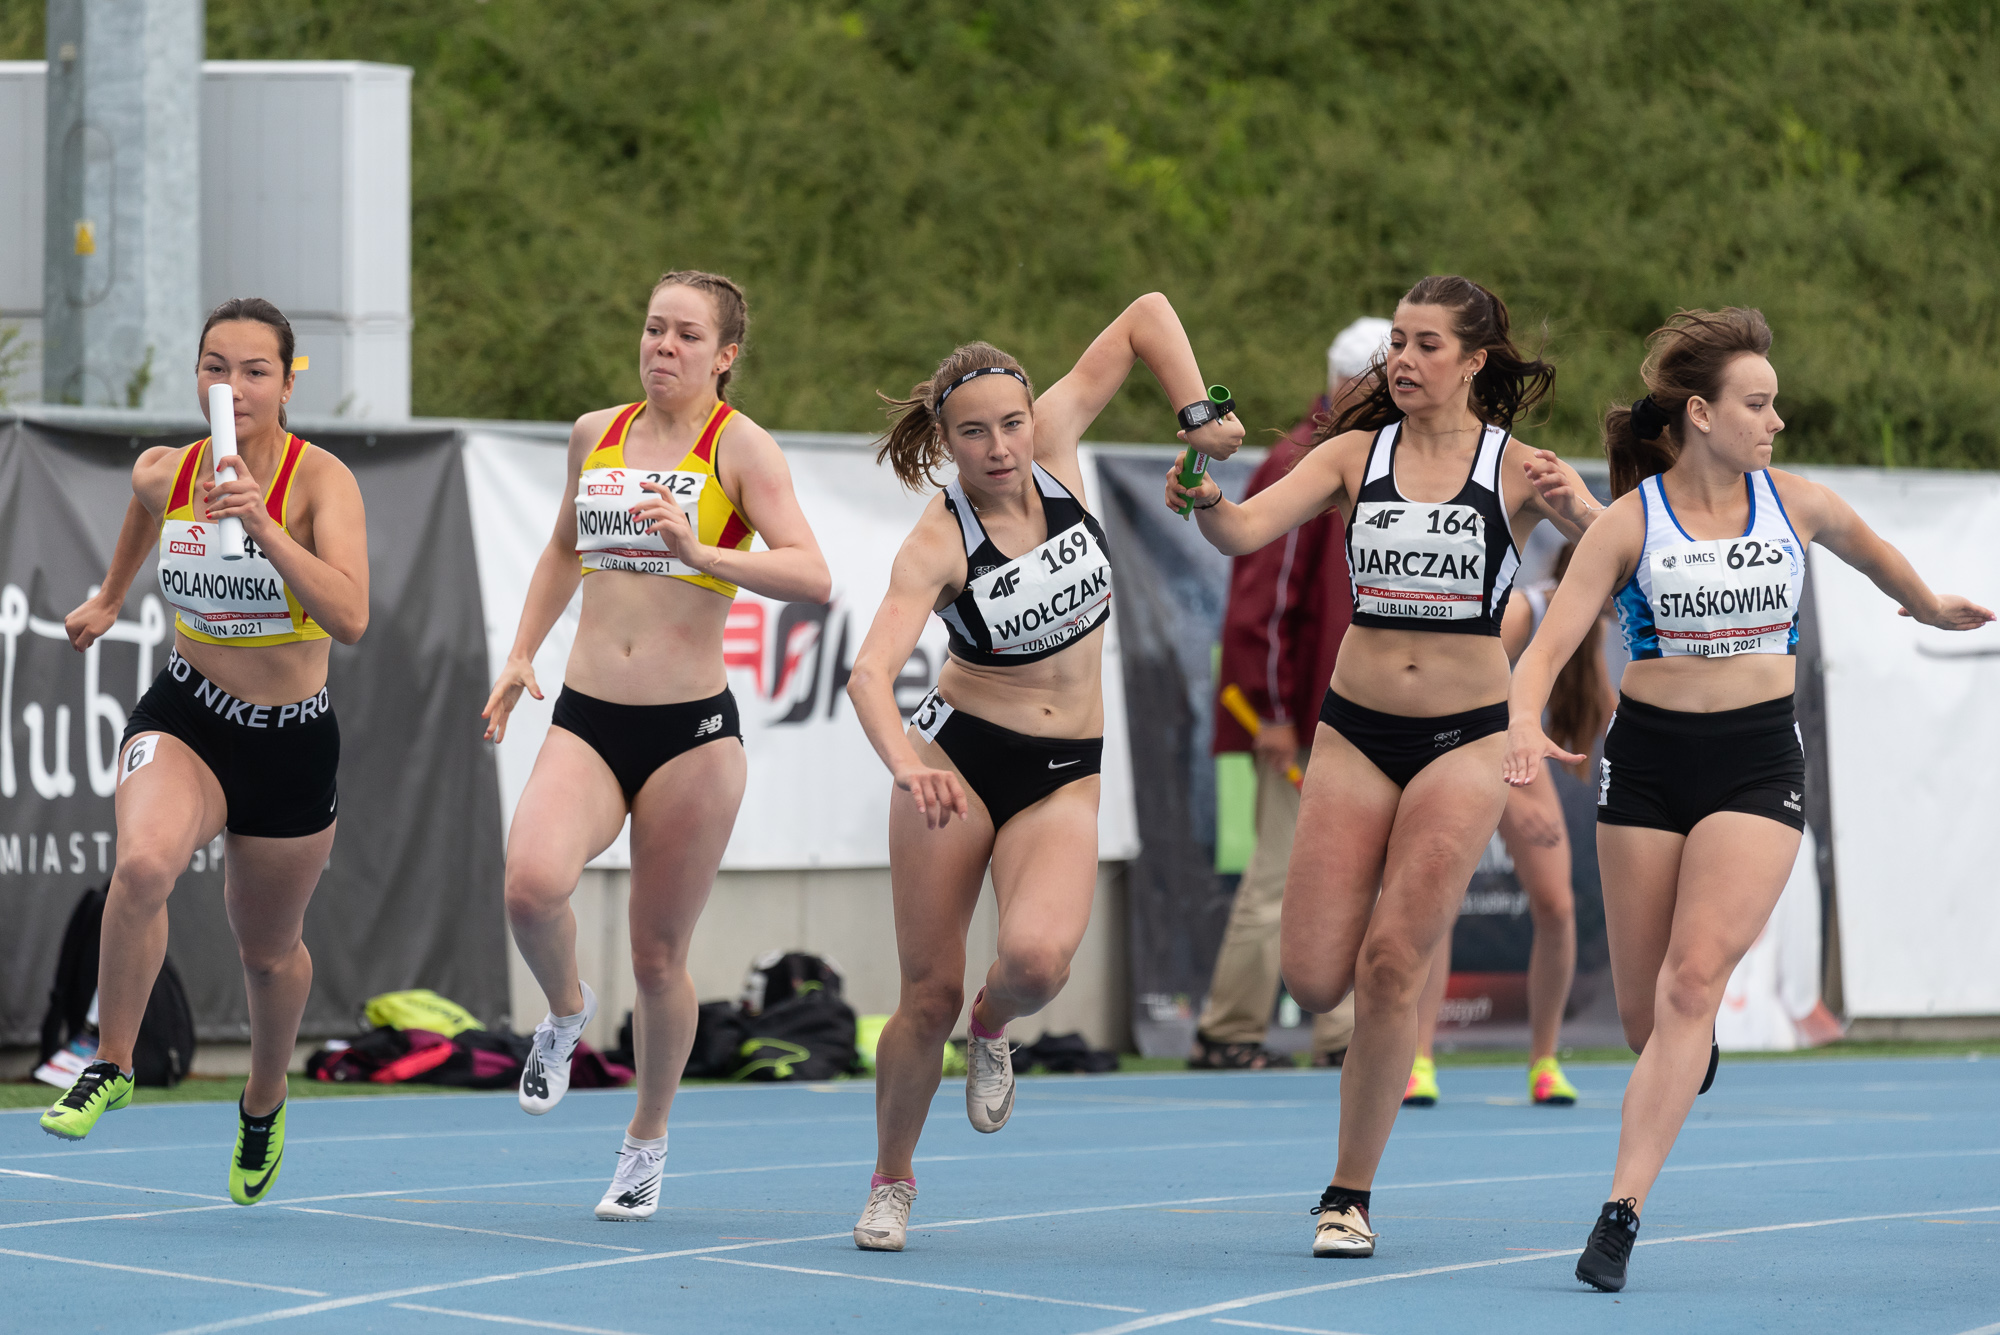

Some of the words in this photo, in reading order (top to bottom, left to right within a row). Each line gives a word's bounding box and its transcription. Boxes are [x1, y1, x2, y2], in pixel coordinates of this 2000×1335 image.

[962, 370, 978, 382] NIKE
[588, 485, 623, 496] ORLEN
[641, 473, 696, 496] 242
[579, 510, 692, 537] NOWAKOW
[1365, 509, 1405, 529] 4F
[1427, 510, 1478, 536] 164
[171, 542, 204, 555] ORLEN
[1041, 531, 1088, 574] 169
[1684, 552, 1715, 564] UMCS
[1726, 540, 1783, 570] 623
[600, 556, 637, 572] LUBLIN
[640, 561, 671, 573] 2021
[1358, 548, 1479, 580] JARCZAK
[162, 568, 281, 601] POLANOWSKA
[988, 566, 1021, 600] 4F
[1384, 590, 1435, 600] MISTRZOSTWA
[994, 566, 1108, 641] WOŁCZAK
[1377, 601, 1418, 616] LUBLIN
[1422, 605, 1453, 617] 2021
[1660, 582, 1788, 618] STAŚKOWIAK
[194, 617, 228, 636] LUBLIN
[231, 621, 263, 636] 2021
[1694, 628, 1746, 639] MISTRZOSTWA
[1747, 625, 1772, 635] POLSKI
[1772, 623, 1788, 631] U20
[1022, 632, 1064, 653] LUBLIN
[1686, 642, 1730, 656] LUBLIN
[1733, 637, 1761, 652] 2021
[167, 645, 192, 683] RO
[193, 678, 272, 729] NIKE
[277, 686, 329, 728] PRO
[917, 691, 946, 731] 5
[127, 740, 147, 773] 6
[0, 831, 112, 875] MIAST
